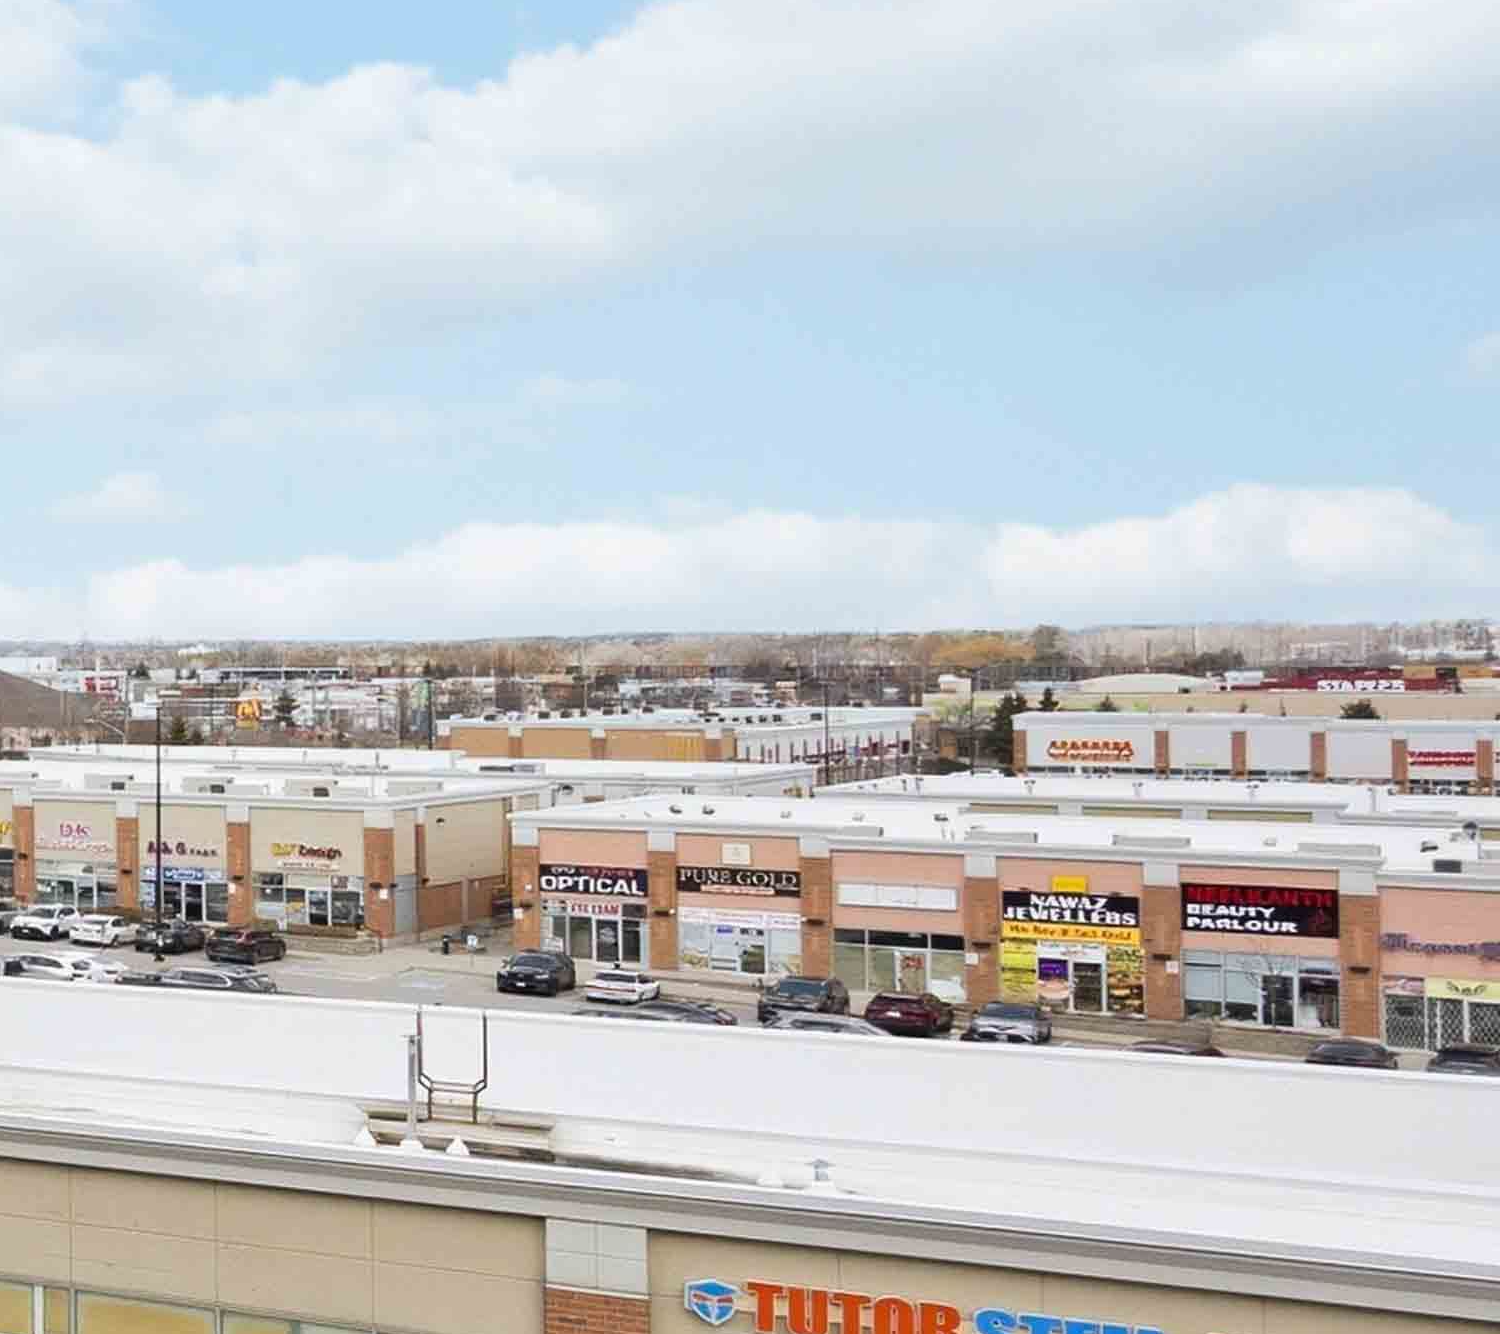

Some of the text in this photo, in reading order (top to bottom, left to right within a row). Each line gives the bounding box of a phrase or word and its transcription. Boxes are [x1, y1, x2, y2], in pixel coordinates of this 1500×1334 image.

[540, 875, 644, 896] OPTICAL
[680, 868, 797, 886] PURE GOLD
[1186, 903, 1275, 918] BEAUTY
[1186, 917, 1298, 933] PARLOUR
